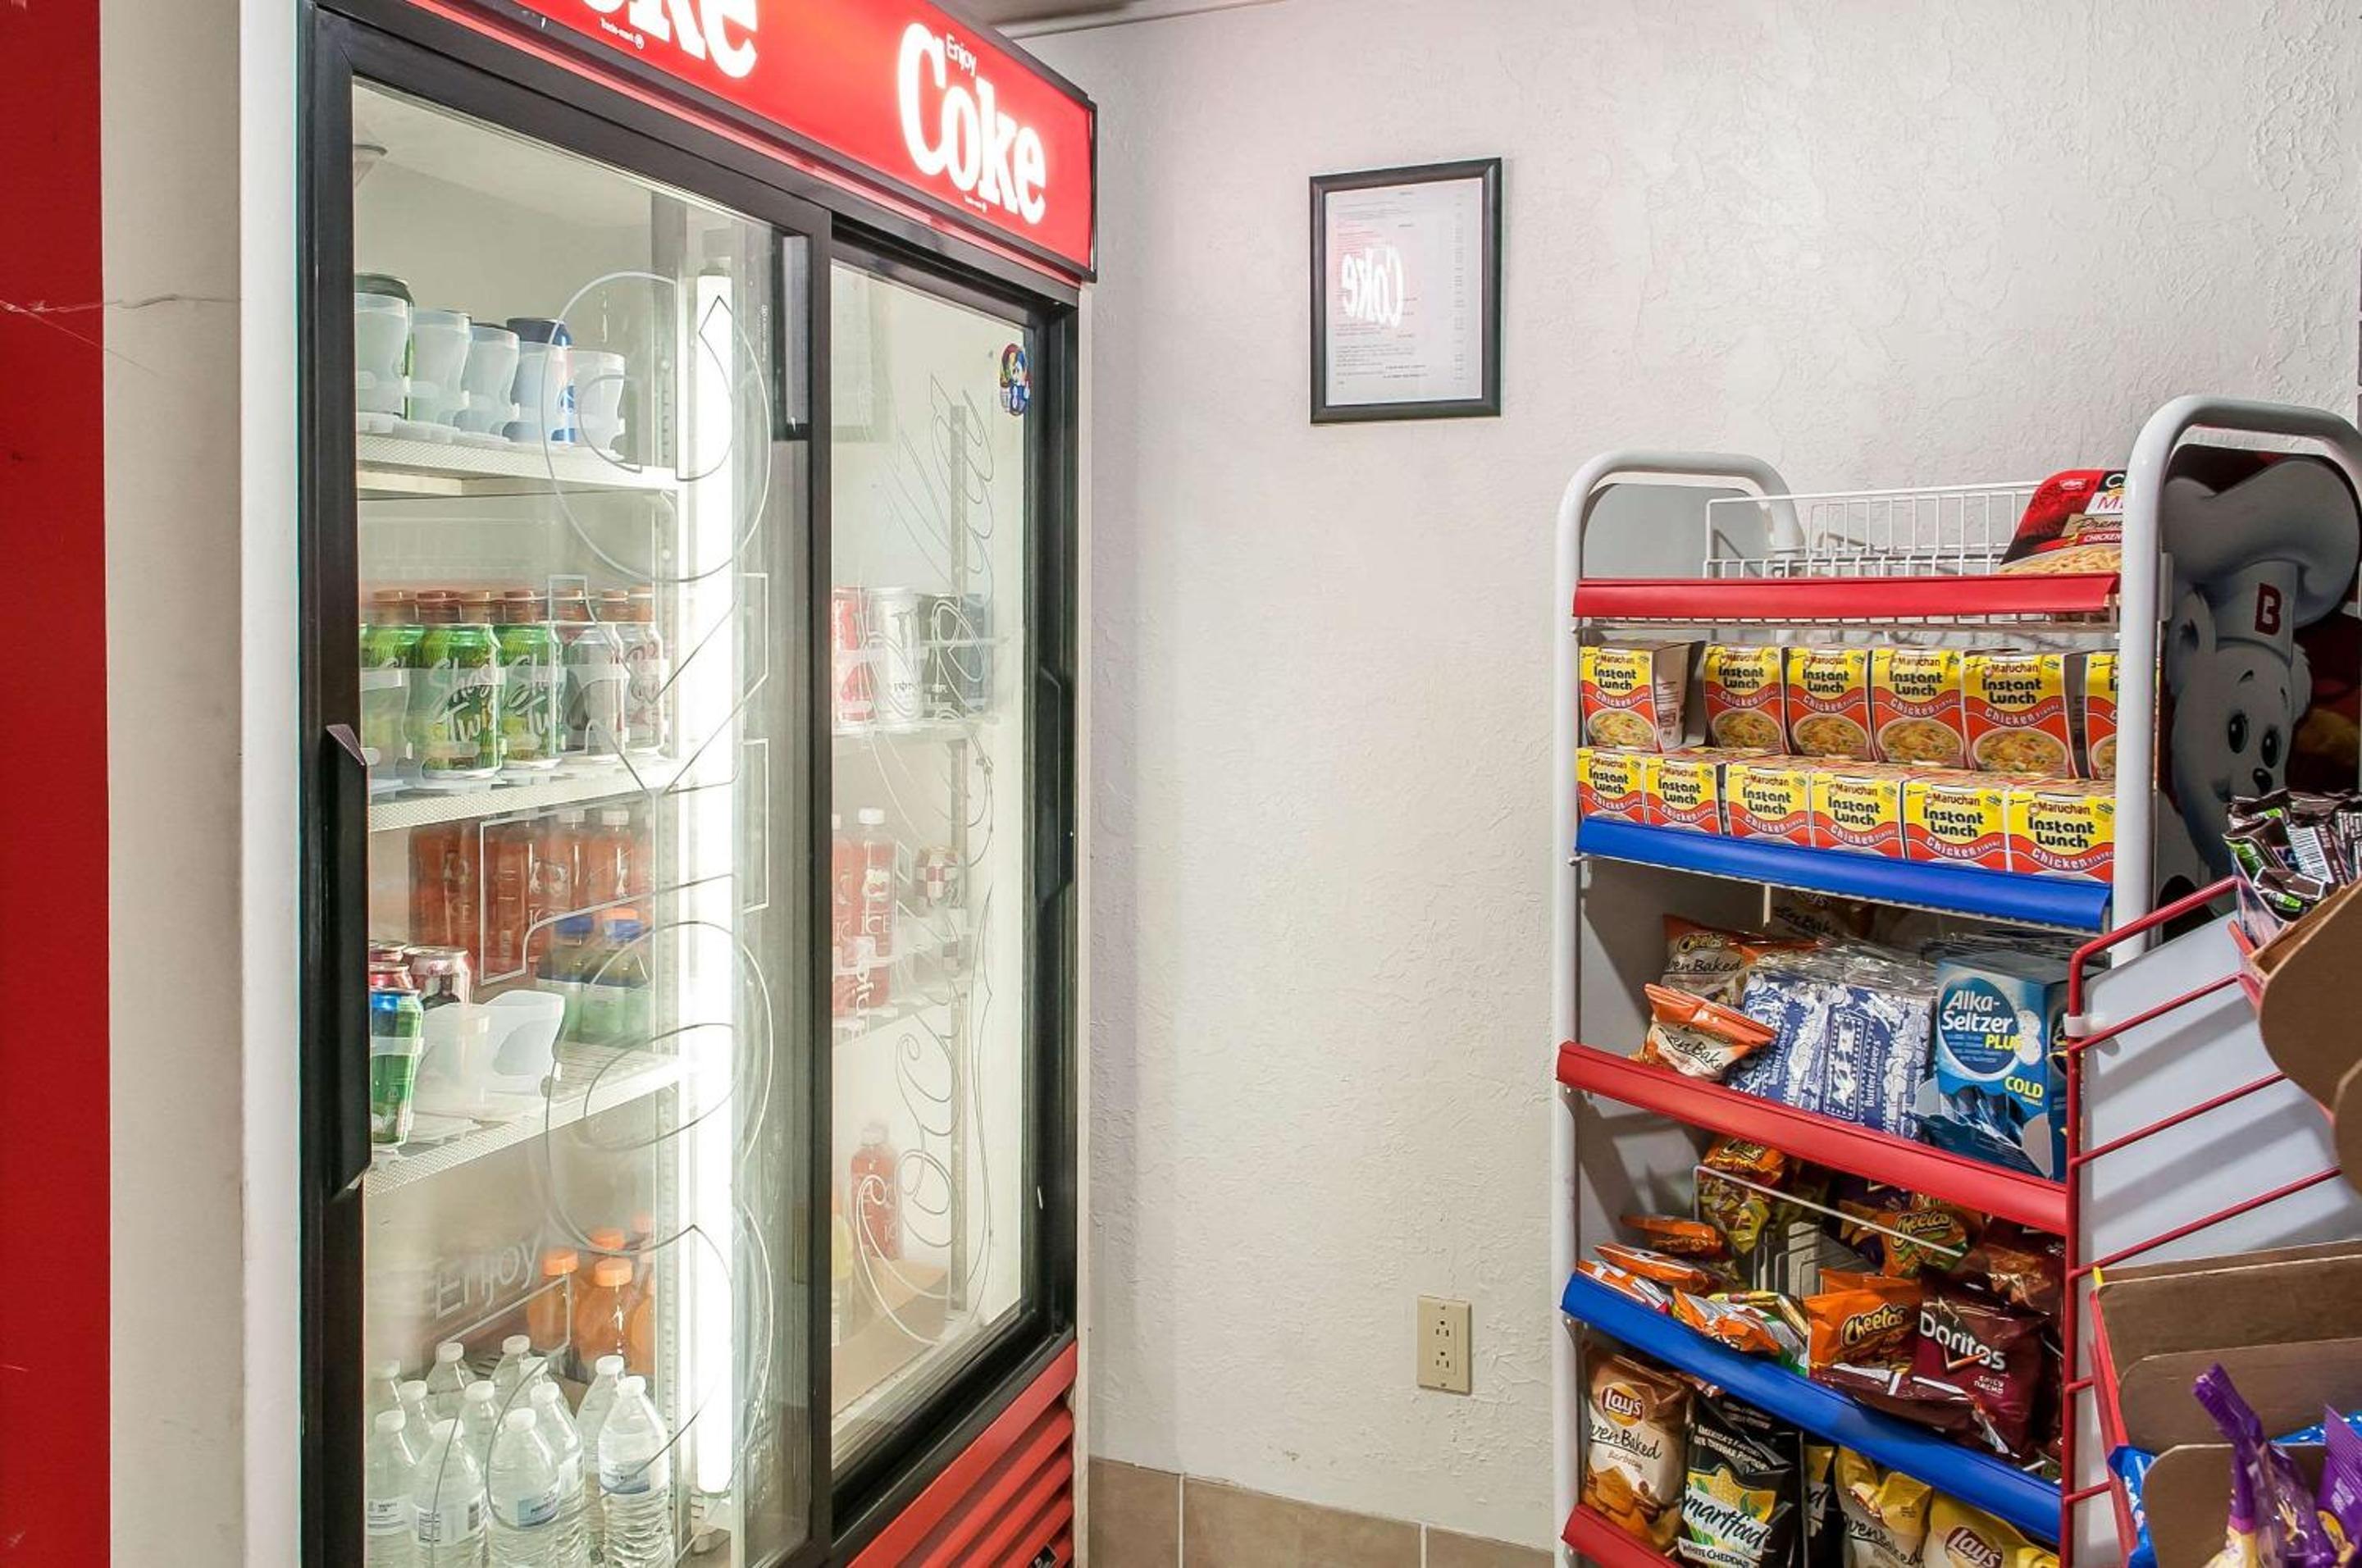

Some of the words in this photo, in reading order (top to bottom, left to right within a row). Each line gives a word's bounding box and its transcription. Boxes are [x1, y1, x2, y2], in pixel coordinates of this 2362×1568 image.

[946, 33, 977, 76] Enjoy
[899, 22, 1046, 225] Coke
[2255, 583, 2282, 636] B
[1594, 667, 1636, 679] Instant
[1719, 666, 1764, 678] Instant
[1803, 669, 1849, 681] Instant
[1992, 663, 2039, 674] Maruchan
[1599, 678, 1632, 691] Lunch
[1724, 678, 1759, 689] Lunch
[1890, 671, 1942, 684] Instant
[1982, 678, 2041, 692] Instant
[1808, 681, 1844, 693] Lunch
[1895, 683, 1936, 696] Lunch
[1990, 691, 2036, 704] Lunch
[1890, 699, 1934, 717] Chicken
[1986, 708, 2035, 727] Chicken
[1589, 768, 1629, 784] Instant
[1594, 781, 1625, 794] Lunch
[1658, 778, 1701, 794] Instant
[1664, 793, 1698, 805] Lunch
[1743, 787, 1791, 803] Instant
[1933, 793, 1980, 806] Maruchan
[1749, 801, 1786, 814] Lunch
[1828, 796, 1881, 814] Instant
[2039, 802, 2090, 814] Maruchan
[1745, 814, 1785, 833] Chicken
[1835, 810, 1876, 825] Lunch
[1924, 806, 1983, 824] Instant
[1931, 821, 1978, 837] Lunch
[2028, 817, 2095, 834] Instant
[1831, 824, 1873, 845] Chicken
[2036, 832, 2088, 849] Lunch
[1927, 836, 1976, 858] Chicken
[2032, 848, 2086, 869] Chicken
[1945, 990, 2000, 1013] Alka-
[1941, 1011, 2013, 1034] Seltzer
[1986, 1034, 2022, 1052] PLUS
[1691, 1041, 1724, 1071] Bake
[1869, 1040, 1881, 1068] Lovers
[1864, 1067, 1876, 1107] Butter
[2004, 1076, 2045, 1099] COLD
[1843, 1305, 1904, 1346] Cheetos
[1919, 1311, 2007, 1370] Doritos
